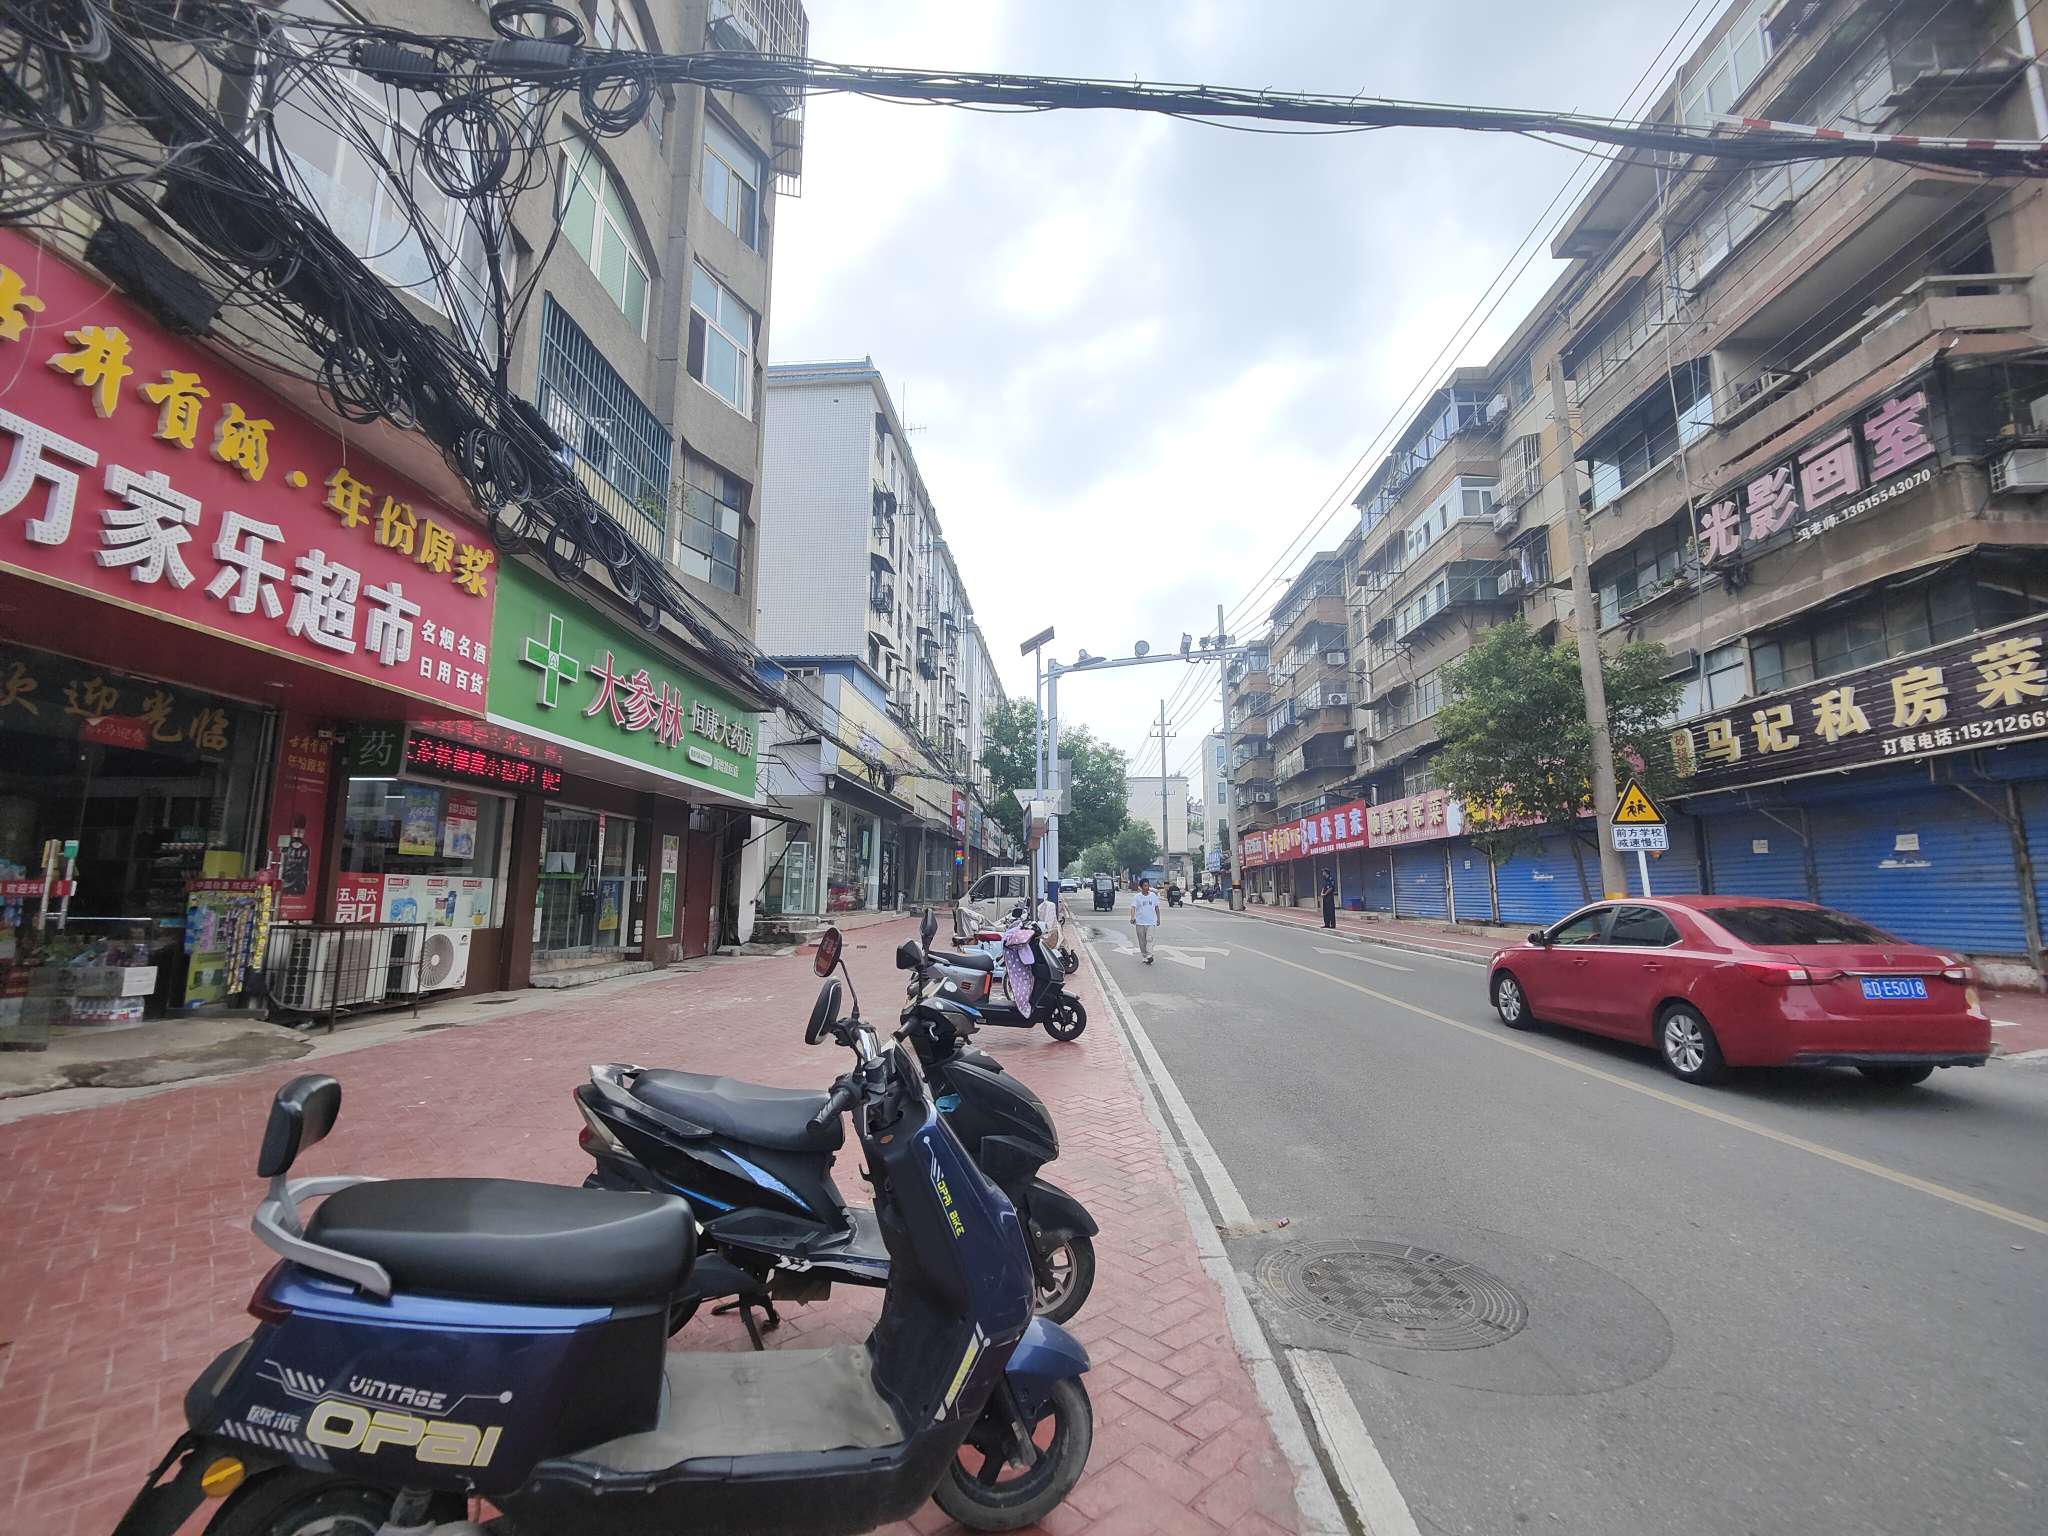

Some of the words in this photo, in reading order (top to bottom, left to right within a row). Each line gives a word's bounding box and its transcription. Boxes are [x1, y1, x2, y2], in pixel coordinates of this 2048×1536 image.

[1698, 392, 1935, 566] 光影画室
[0, 409, 422, 666] 万家乐超市
[421, 619, 487, 665] 名烟名酒
[418, 655, 484, 696] 日用百货
[588, 651, 684, 747] 大参林
[1703, 636, 2048, 763] 马记私房菜
[359, 730, 396, 767] 药
[691, 700, 754, 758] 恒康大药房
[1882, 710, 2048, 755] 订餐电话:1521266
[1615, 828, 1663, 838] 前方学校
[1617, 838, 1665, 848] 减速慢行
[6, 883, 44, 894] 欢迎光
[336, 888, 378, 902] 五、周六
